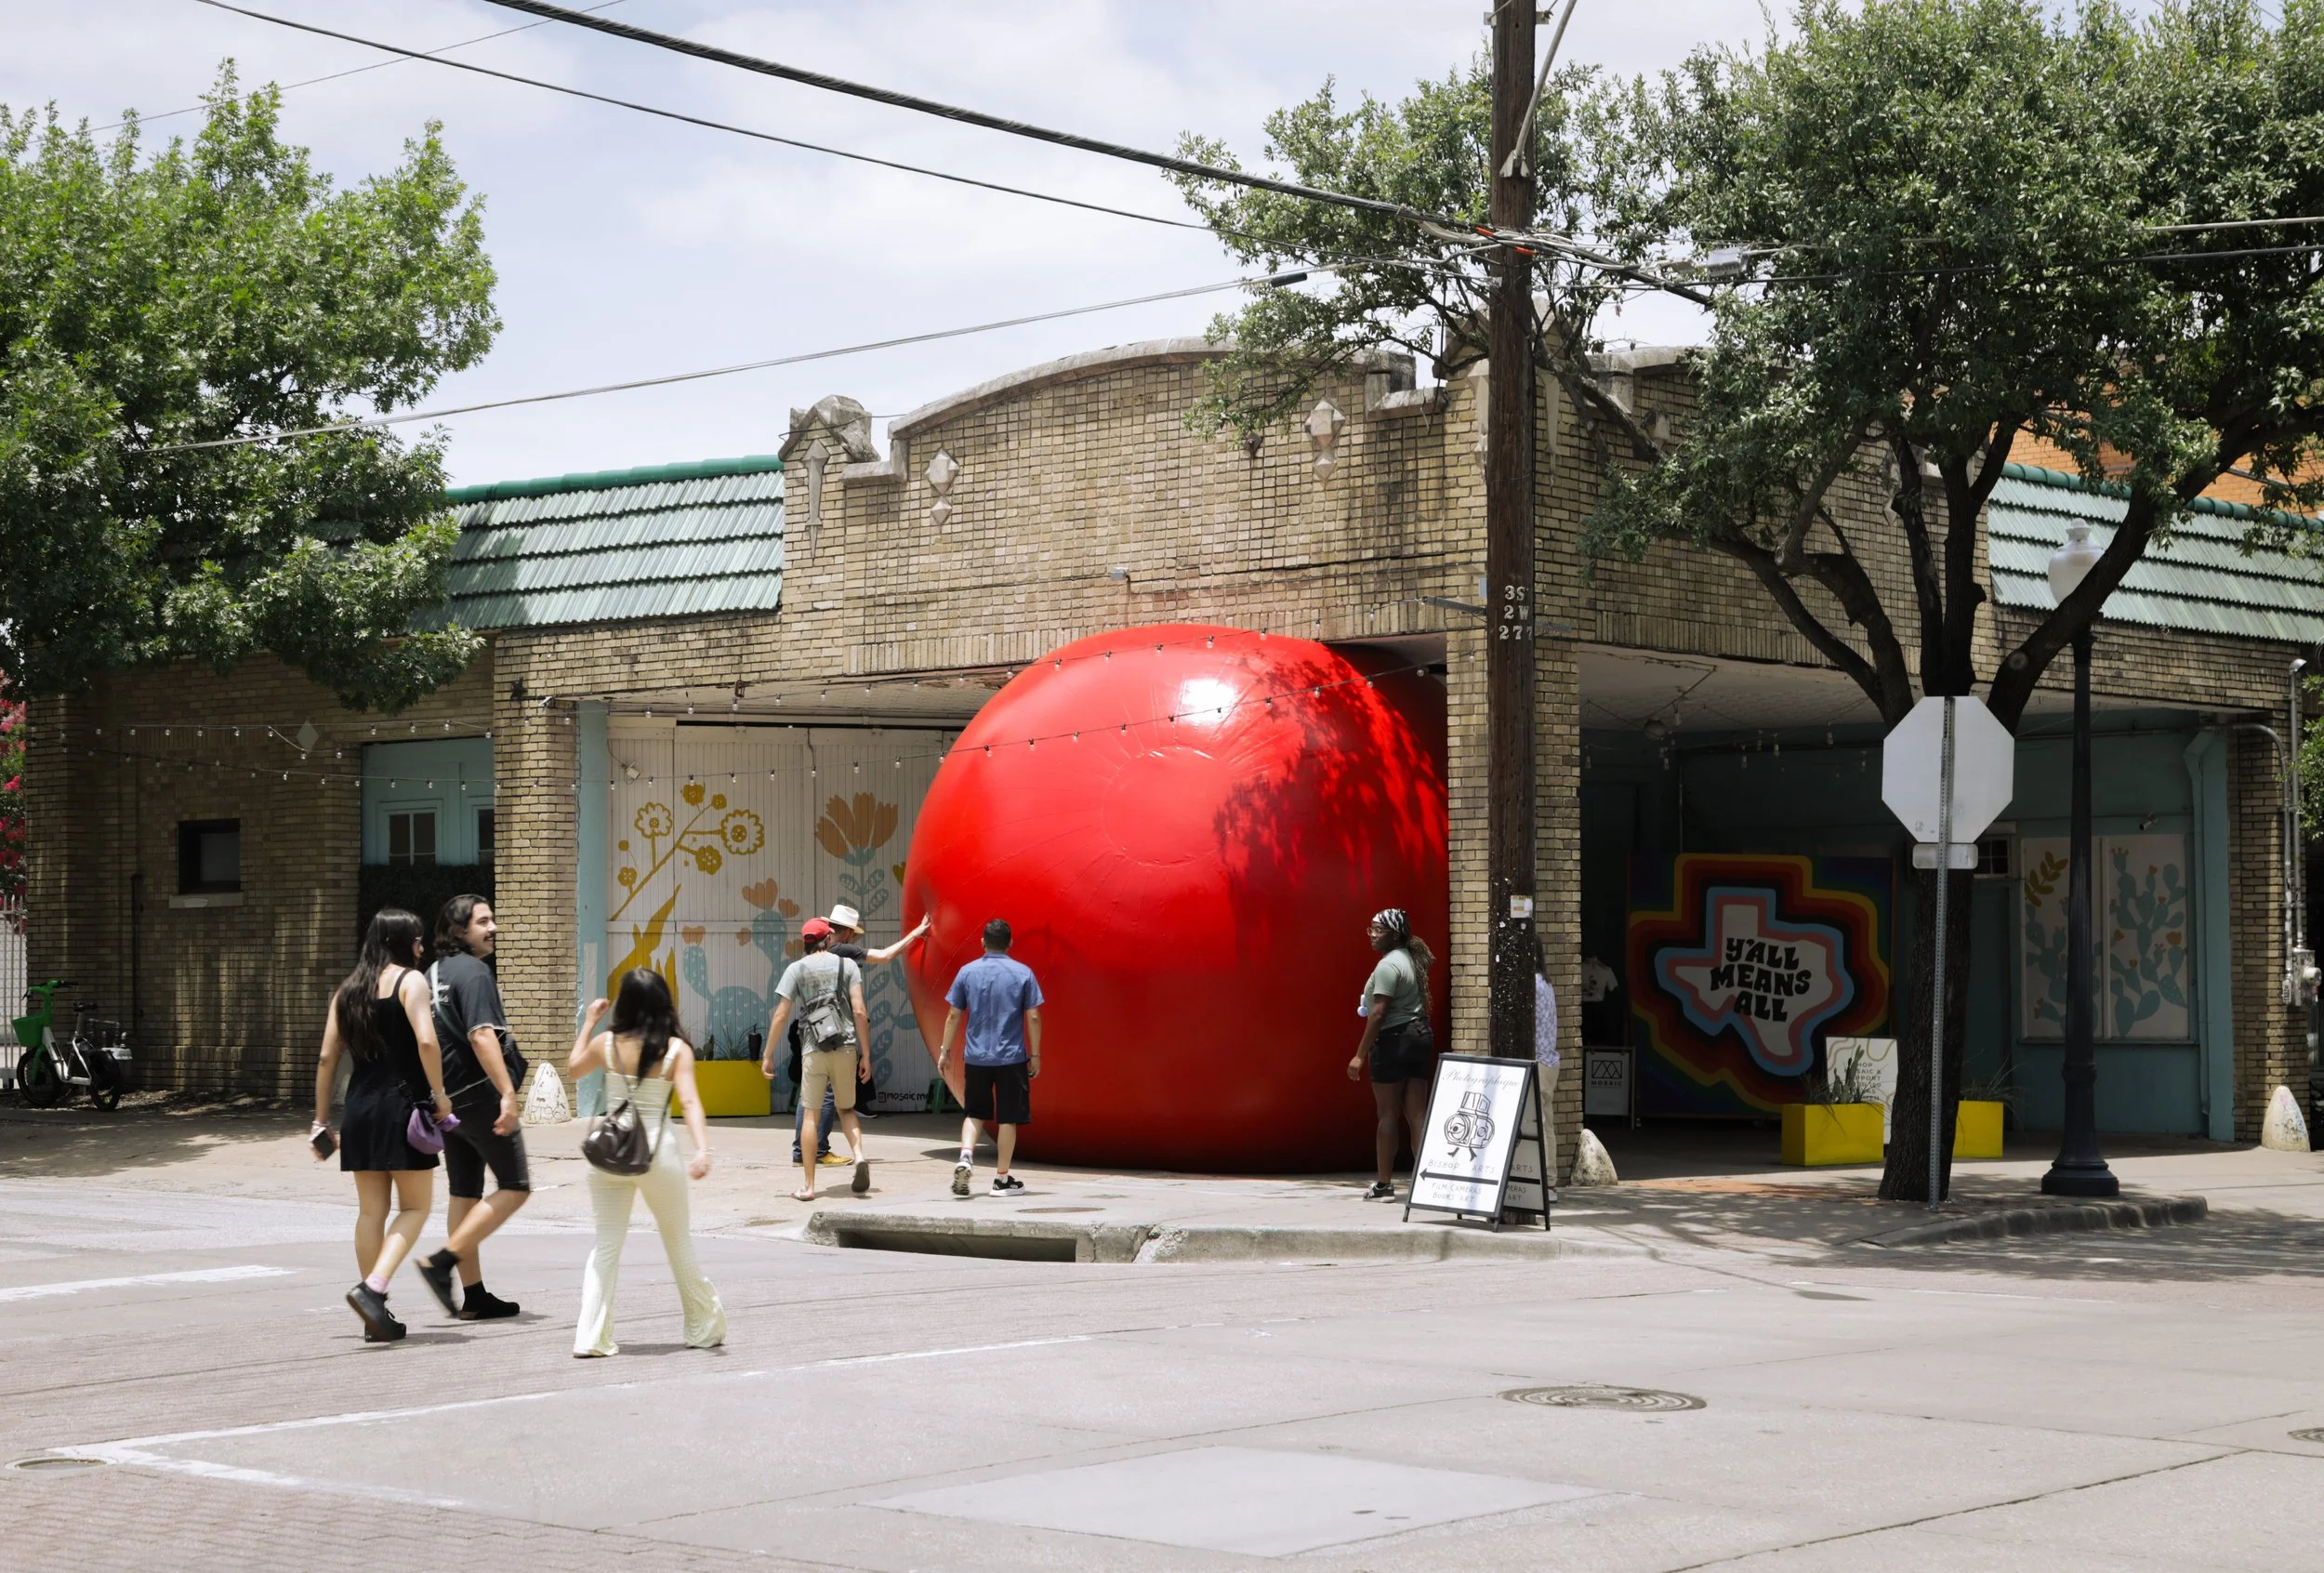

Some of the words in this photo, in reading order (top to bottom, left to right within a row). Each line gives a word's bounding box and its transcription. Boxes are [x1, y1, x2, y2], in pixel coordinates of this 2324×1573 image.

[1725, 937, 1799, 971] Y'ALL
[1710, 964, 1813, 997] MEANS
[1733, 991, 1788, 1022] ALL
[1442, 1069, 1518, 1090] Photographique
[1428, 1159, 1459, 1169] BISHOP
[1472, 1165, 1495, 1173] ARTS
[1450, 1183, 1482, 1195] CAMERAS
